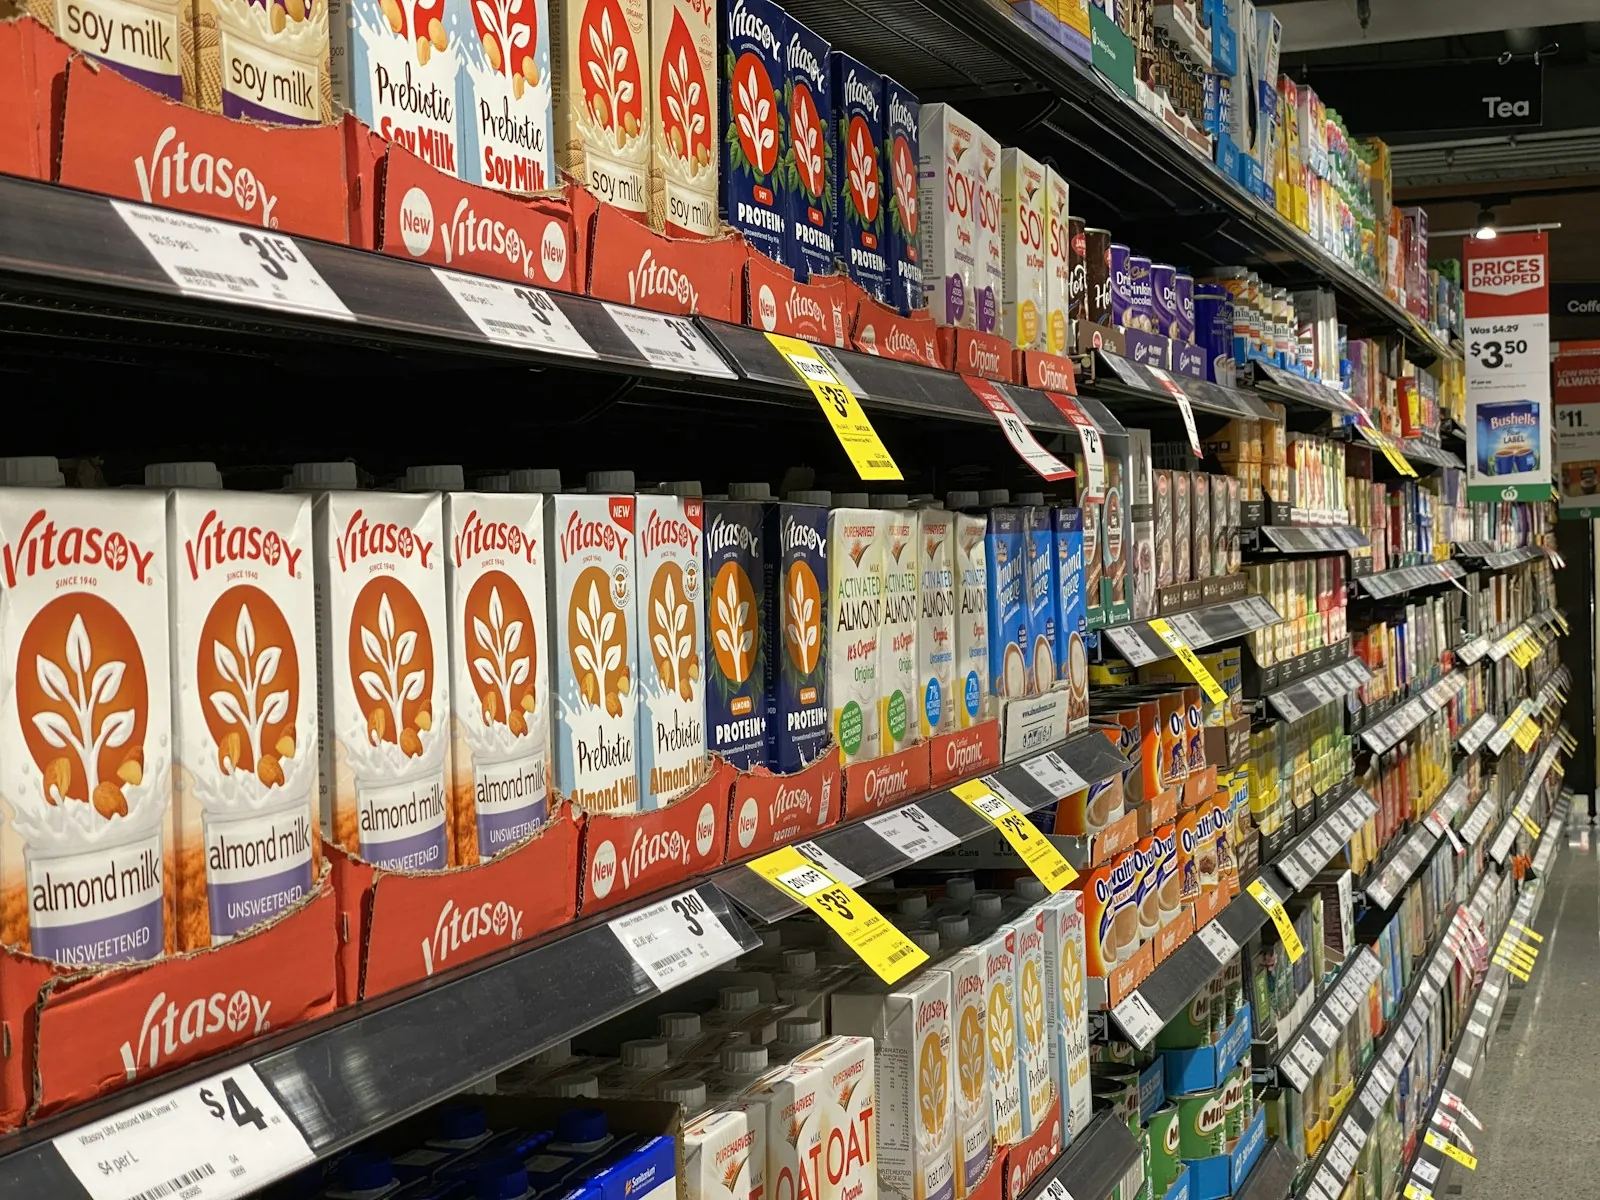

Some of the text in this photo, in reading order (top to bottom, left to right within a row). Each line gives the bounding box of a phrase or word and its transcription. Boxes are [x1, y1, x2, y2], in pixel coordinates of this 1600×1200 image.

[68, 4, 172, 63] soy milk
[232, 56, 313, 109] soy milk
[375, 62, 453, 124] Prebiotic
[1482, 97, 1529, 118] Tea
[480, 97, 544, 152] Prebiotic
[381, 116, 455, 172] Soy Milk
[485, 145, 545, 190] Soy Milk
[592, 169, 643, 205] soy milk
[947, 167, 975, 223] SOY
[403, 209, 430, 236] New
[670, 195, 713, 229] soy milk
[543, 238, 565, 263] New
[1472, 258, 1540, 276] PRICES
[1472, 274, 1540, 287] DROPPED
[760, 298, 775, 317] New
[1470, 324, 1519, 334] Was $4.29
[969, 338, 999, 376] Organic
[1038, 359, 1068, 389] Organic
[1557, 370, 1578, 378] LOW
[1491, 412, 1536, 430] Bushells
[1560, 411, 1583, 427] $11
[1504, 436, 1525, 444] LABEL
[613, 505, 630, 518] NEW
[687, 506, 700, 516] NEW
[226, 570, 258, 582] SINCE 1940
[369, 563, 395, 573] SINCE 1940
[481, 559, 494, 569] SINCE
[56, 576, 97, 589] SINCE 1940
[838, 577, 881, 598] ACTIVATED
[885, 574, 917, 593] ACTIVATED
[922, 571, 953, 588] ACTIVATED
[837, 600, 882, 632] ALMOND
[885, 595, 917, 625] ALMOND
[922, 591, 953, 619] ALMOND
[854, 664, 875, 683] Original
[969, 677, 978, 690] 7%
[929, 685, 939, 699] 7%
[732, 700, 750, 712] ALMOND
[656, 709, 701, 754] Prebiotic
[577, 725, 632, 775] Prebiotic
[947, 734, 982, 775] Organic
[477, 759, 546, 804] almond milk
[619, 775, 637, 809] Milk
[649, 763, 690, 796] Almond
[865, 761, 908, 807] Organic
[361, 783, 444, 832] almond milk
[489, 817, 541, 843] UNSWEETENED
[699, 823, 713, 840] New
[740, 817, 755, 835] New
[209, 816, 310, 871] almond milk
[33, 849, 160, 911] almond milk
[594, 859, 613, 880] New
[787, 869, 822, 889] 20% OFF
[227, 885, 302, 919] UNSWEETENED
[833, 1059, 865, 1086] PUREHARVEST
[200, 1077, 268, 1131] $4
[781, 1092, 815, 1120] PUREHARVEST
[861, 1098, 873, 1109] MILK
[995, 1081, 1019, 1121] Prebiotic
[1226, 1087, 1243, 1104] MIL
[78, 1105, 172, 1147] Vitasoy Uht Almond Milk Unsw
[271, 1117, 281, 1125] ea
[1203, 1106, 1224, 1127] MIL
[715, 1129, 755, 1165] PUREHARVEST
[810, 1135, 822, 1145] MILK
[827, 1107, 873, 1185] OAT
[98, 1150, 139, 1176] $4 per L
[632, 1166, 656, 1187] Sanitarium
